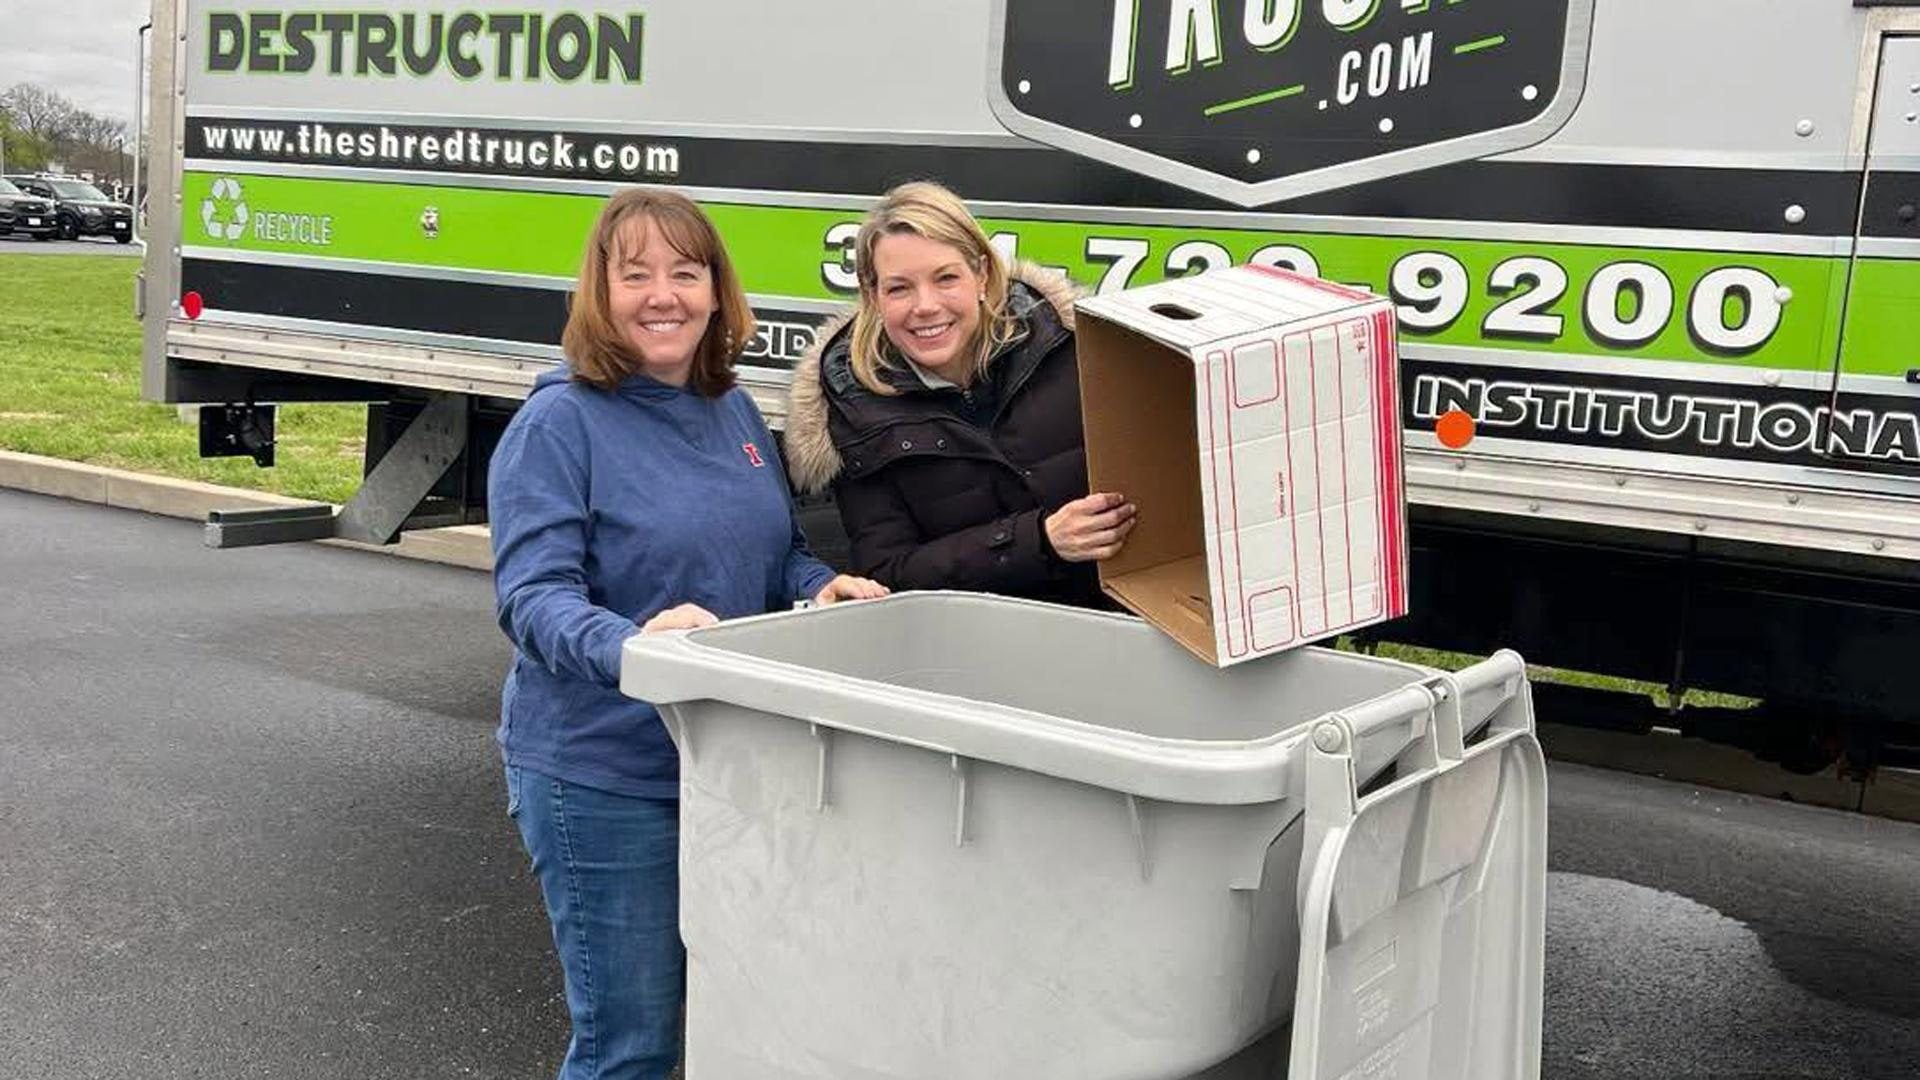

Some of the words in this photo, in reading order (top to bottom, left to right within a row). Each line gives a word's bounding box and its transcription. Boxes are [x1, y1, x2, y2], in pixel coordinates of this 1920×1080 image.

[205, 11, 646, 85] DESTRUCTION
[1318, 31, 1434, 110] .COM
[203, 124, 680, 175] www.theshredtruck.com
[254, 211, 333, 246] RECYCLE
